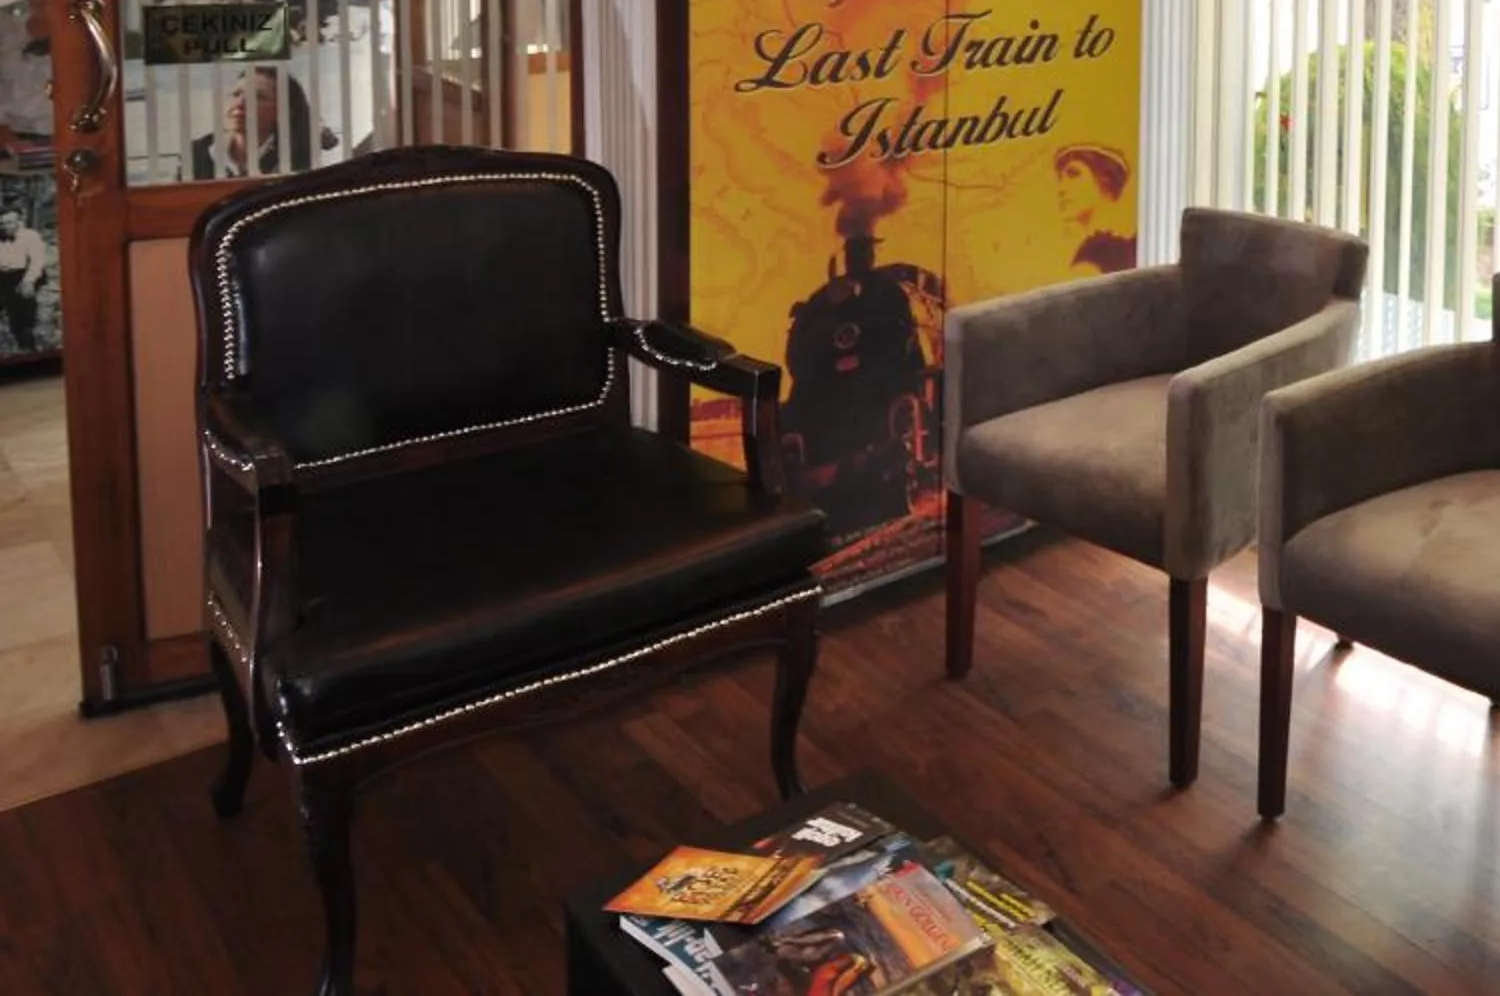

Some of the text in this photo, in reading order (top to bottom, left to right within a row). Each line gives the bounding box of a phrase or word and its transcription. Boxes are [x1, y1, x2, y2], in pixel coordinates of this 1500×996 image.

[184, 37, 256, 55] PULL
[734, 8, 1116, 94] Last Train to
[816, 88, 1064, 170] Istanbul
